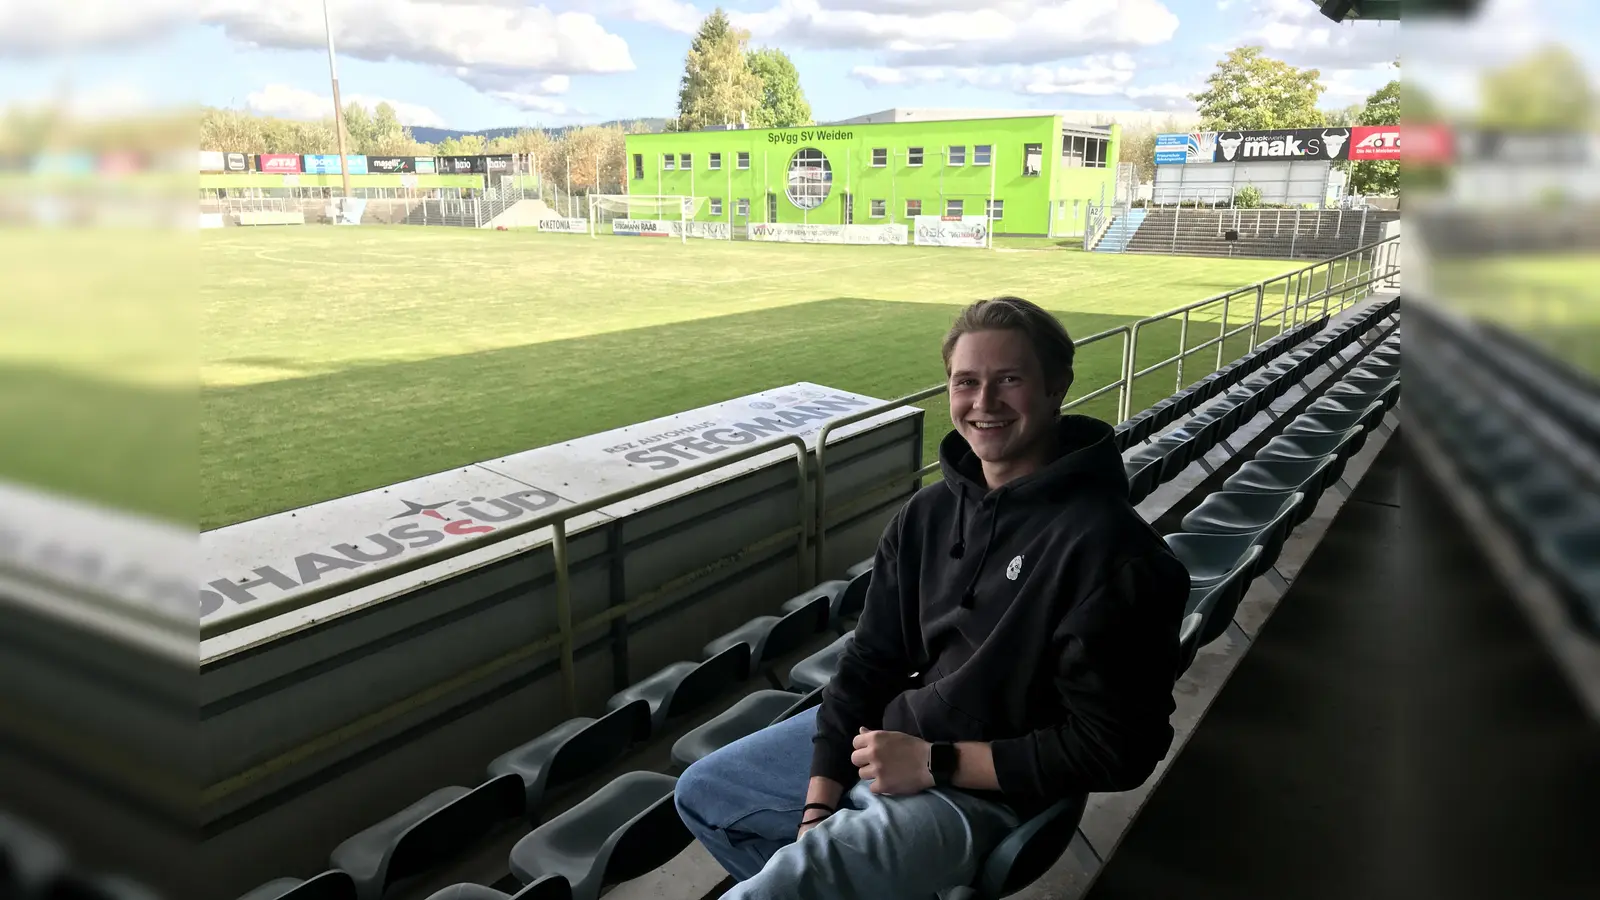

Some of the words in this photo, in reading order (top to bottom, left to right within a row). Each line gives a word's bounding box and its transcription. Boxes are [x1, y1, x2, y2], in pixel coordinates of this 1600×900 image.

[768, 132, 798, 144] SpVgg
[801, 131, 815, 142] SV
[816, 130, 853, 141] Weiden
[1090, 208, 1099, 216] A2
[546, 219, 571, 230] KETONIA
[640, 222, 657, 231] RAAB
[603, 441, 636, 455] RSZ
[637, 420, 717, 447] AUTOHAUS
[624, 394, 869, 471] STEGMANN
